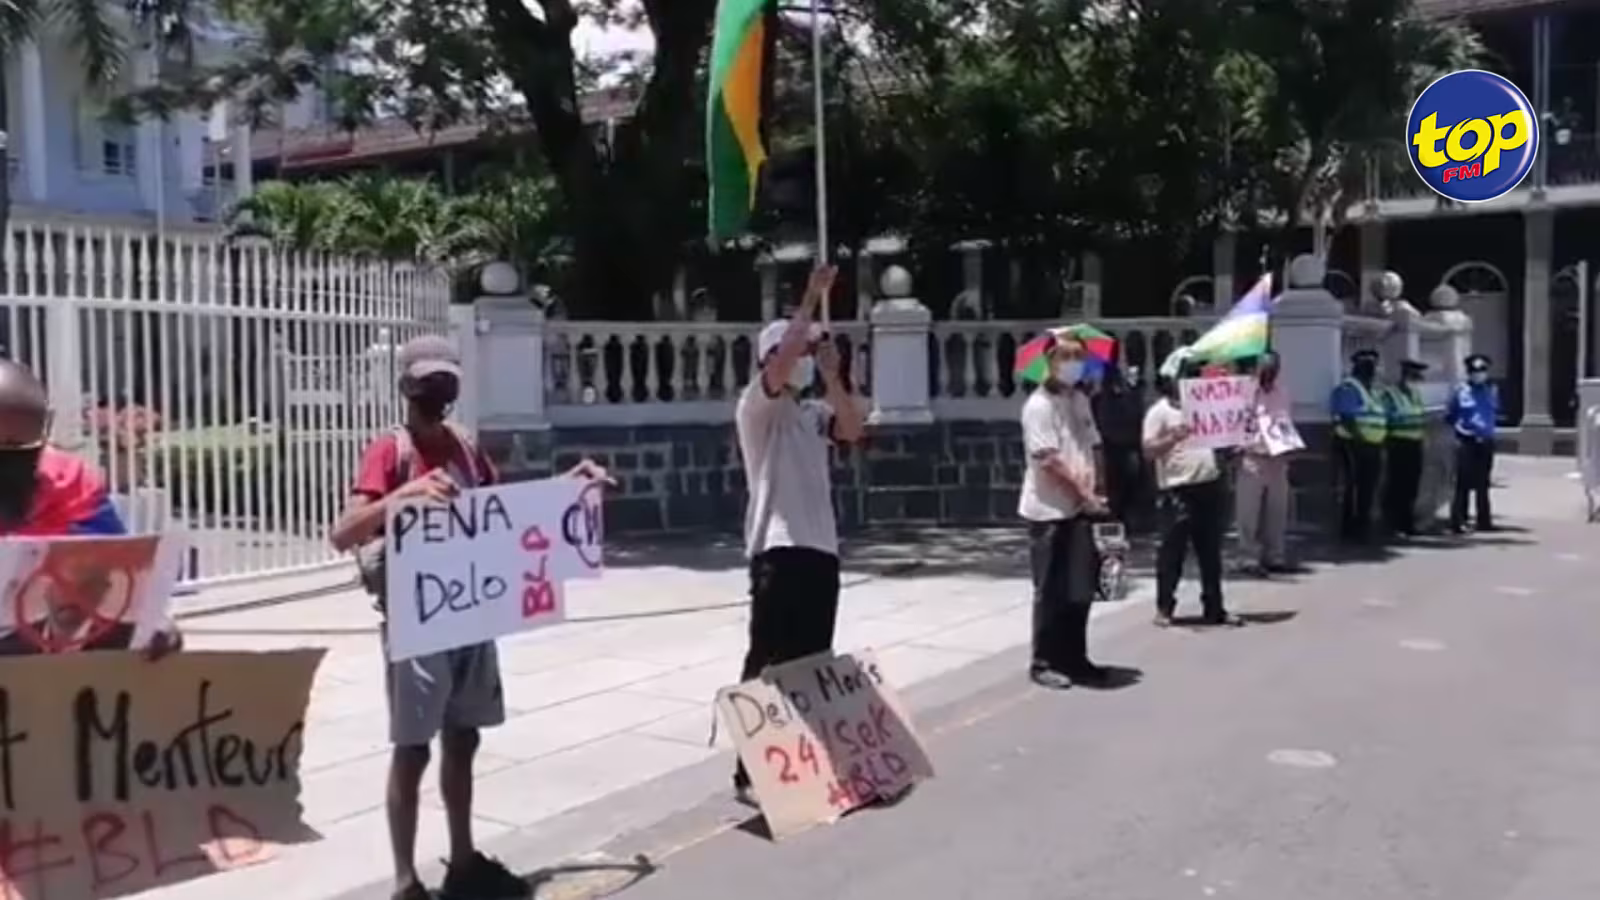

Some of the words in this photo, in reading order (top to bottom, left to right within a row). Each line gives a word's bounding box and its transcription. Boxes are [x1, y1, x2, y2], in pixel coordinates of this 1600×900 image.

[393, 494, 512, 554] PENA
[415, 561, 508, 625] Delo
[728, 678, 812, 738] Delo
[73, 679, 305, 803] Menteur
